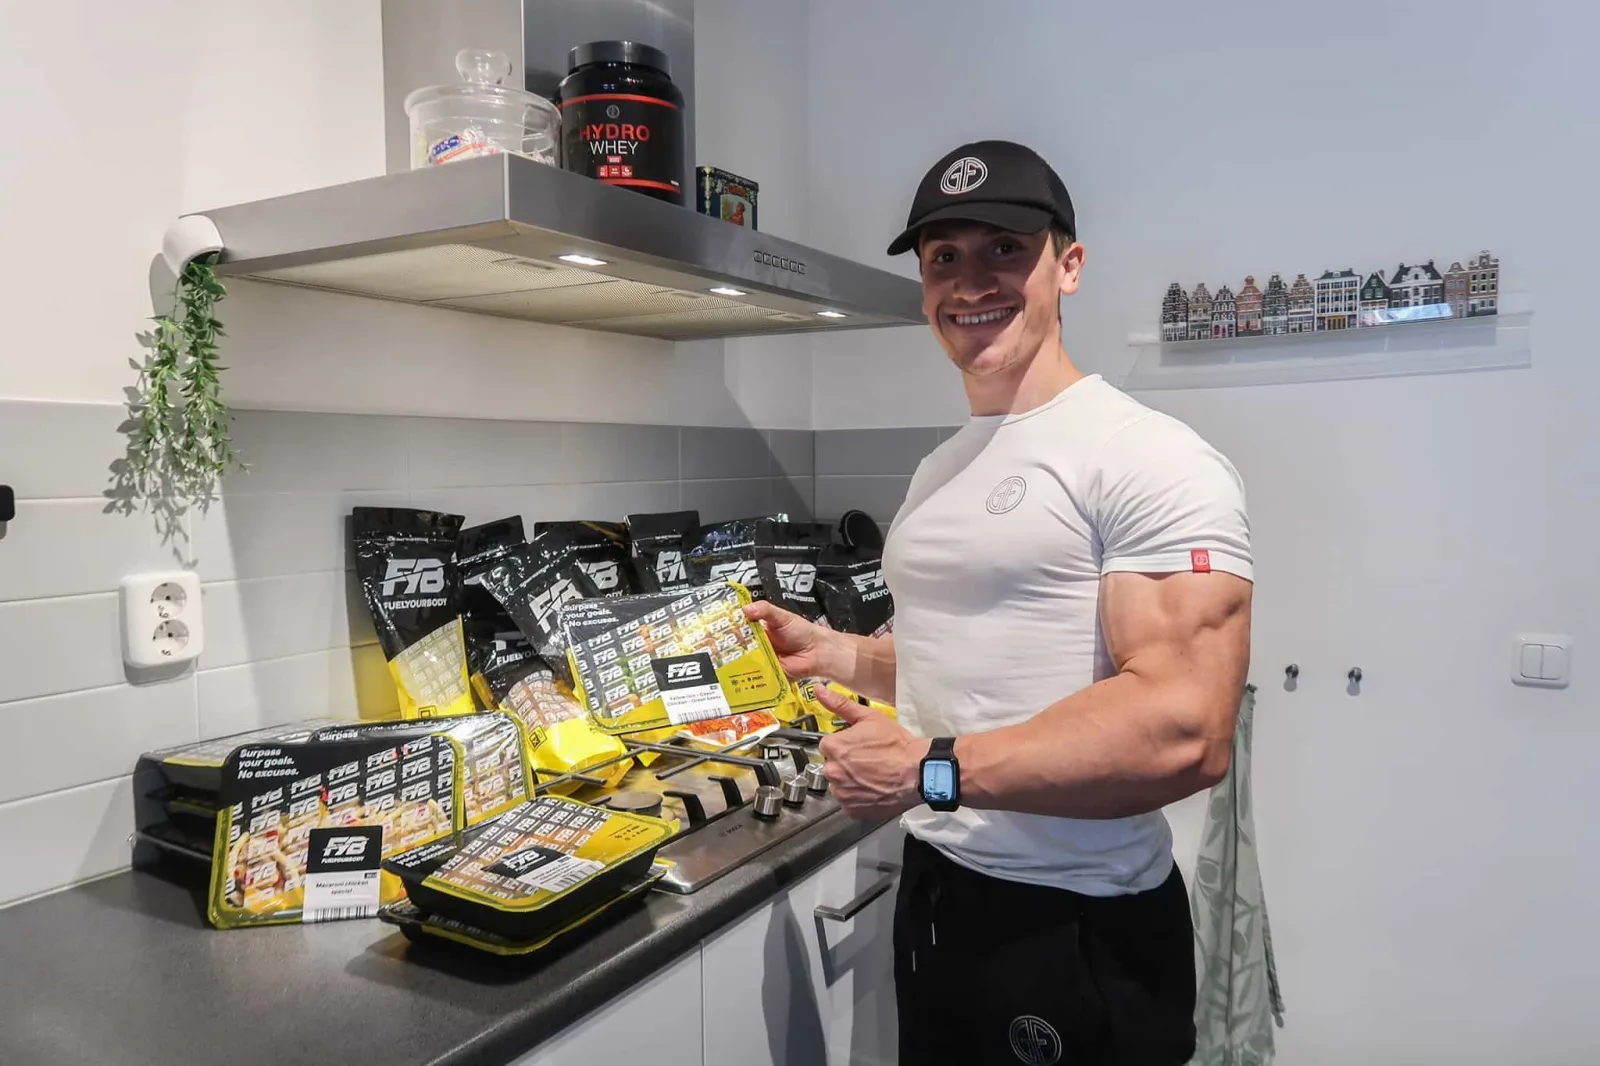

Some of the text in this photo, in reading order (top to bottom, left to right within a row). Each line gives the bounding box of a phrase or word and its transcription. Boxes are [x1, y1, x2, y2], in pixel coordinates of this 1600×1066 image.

[580, 123, 650, 141] HYDRO
[589, 140, 639, 155] WHEY
[383, 598, 447, 610] FUELYOURBODY
[566, 609, 612, 620] your goals.
[583, 617, 619, 626] excuses.
[319, 732, 358, 741] Surpass
[240, 749, 281, 758] Surpass
[238, 756, 295, 770] your goals.
[238, 768, 299, 779] No excuses.
